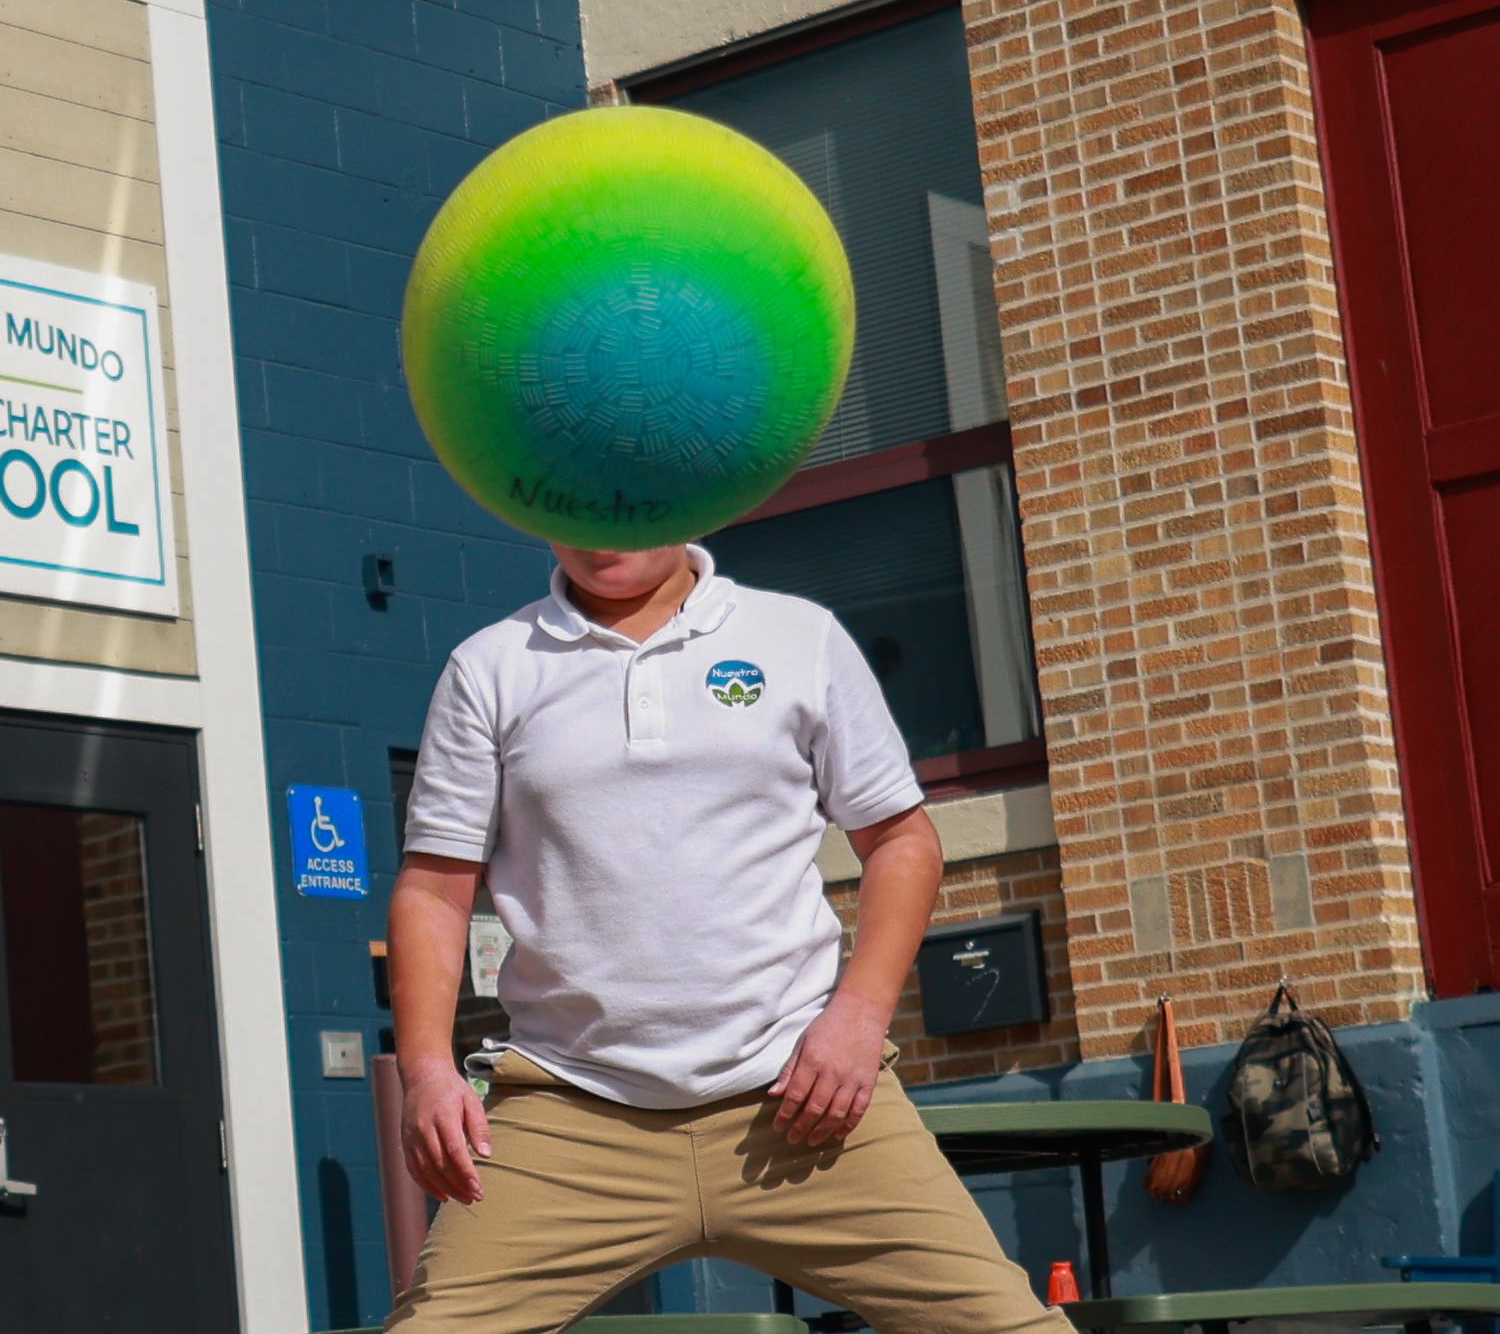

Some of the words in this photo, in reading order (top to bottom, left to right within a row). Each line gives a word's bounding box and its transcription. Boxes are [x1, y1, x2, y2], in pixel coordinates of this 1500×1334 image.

[5, 311, 124, 382] MUNDO
[509, 476, 673, 523] Nuestro
[307, 857, 355, 873] ACCESS
[300, 873, 362, 892] ENTRANCE
